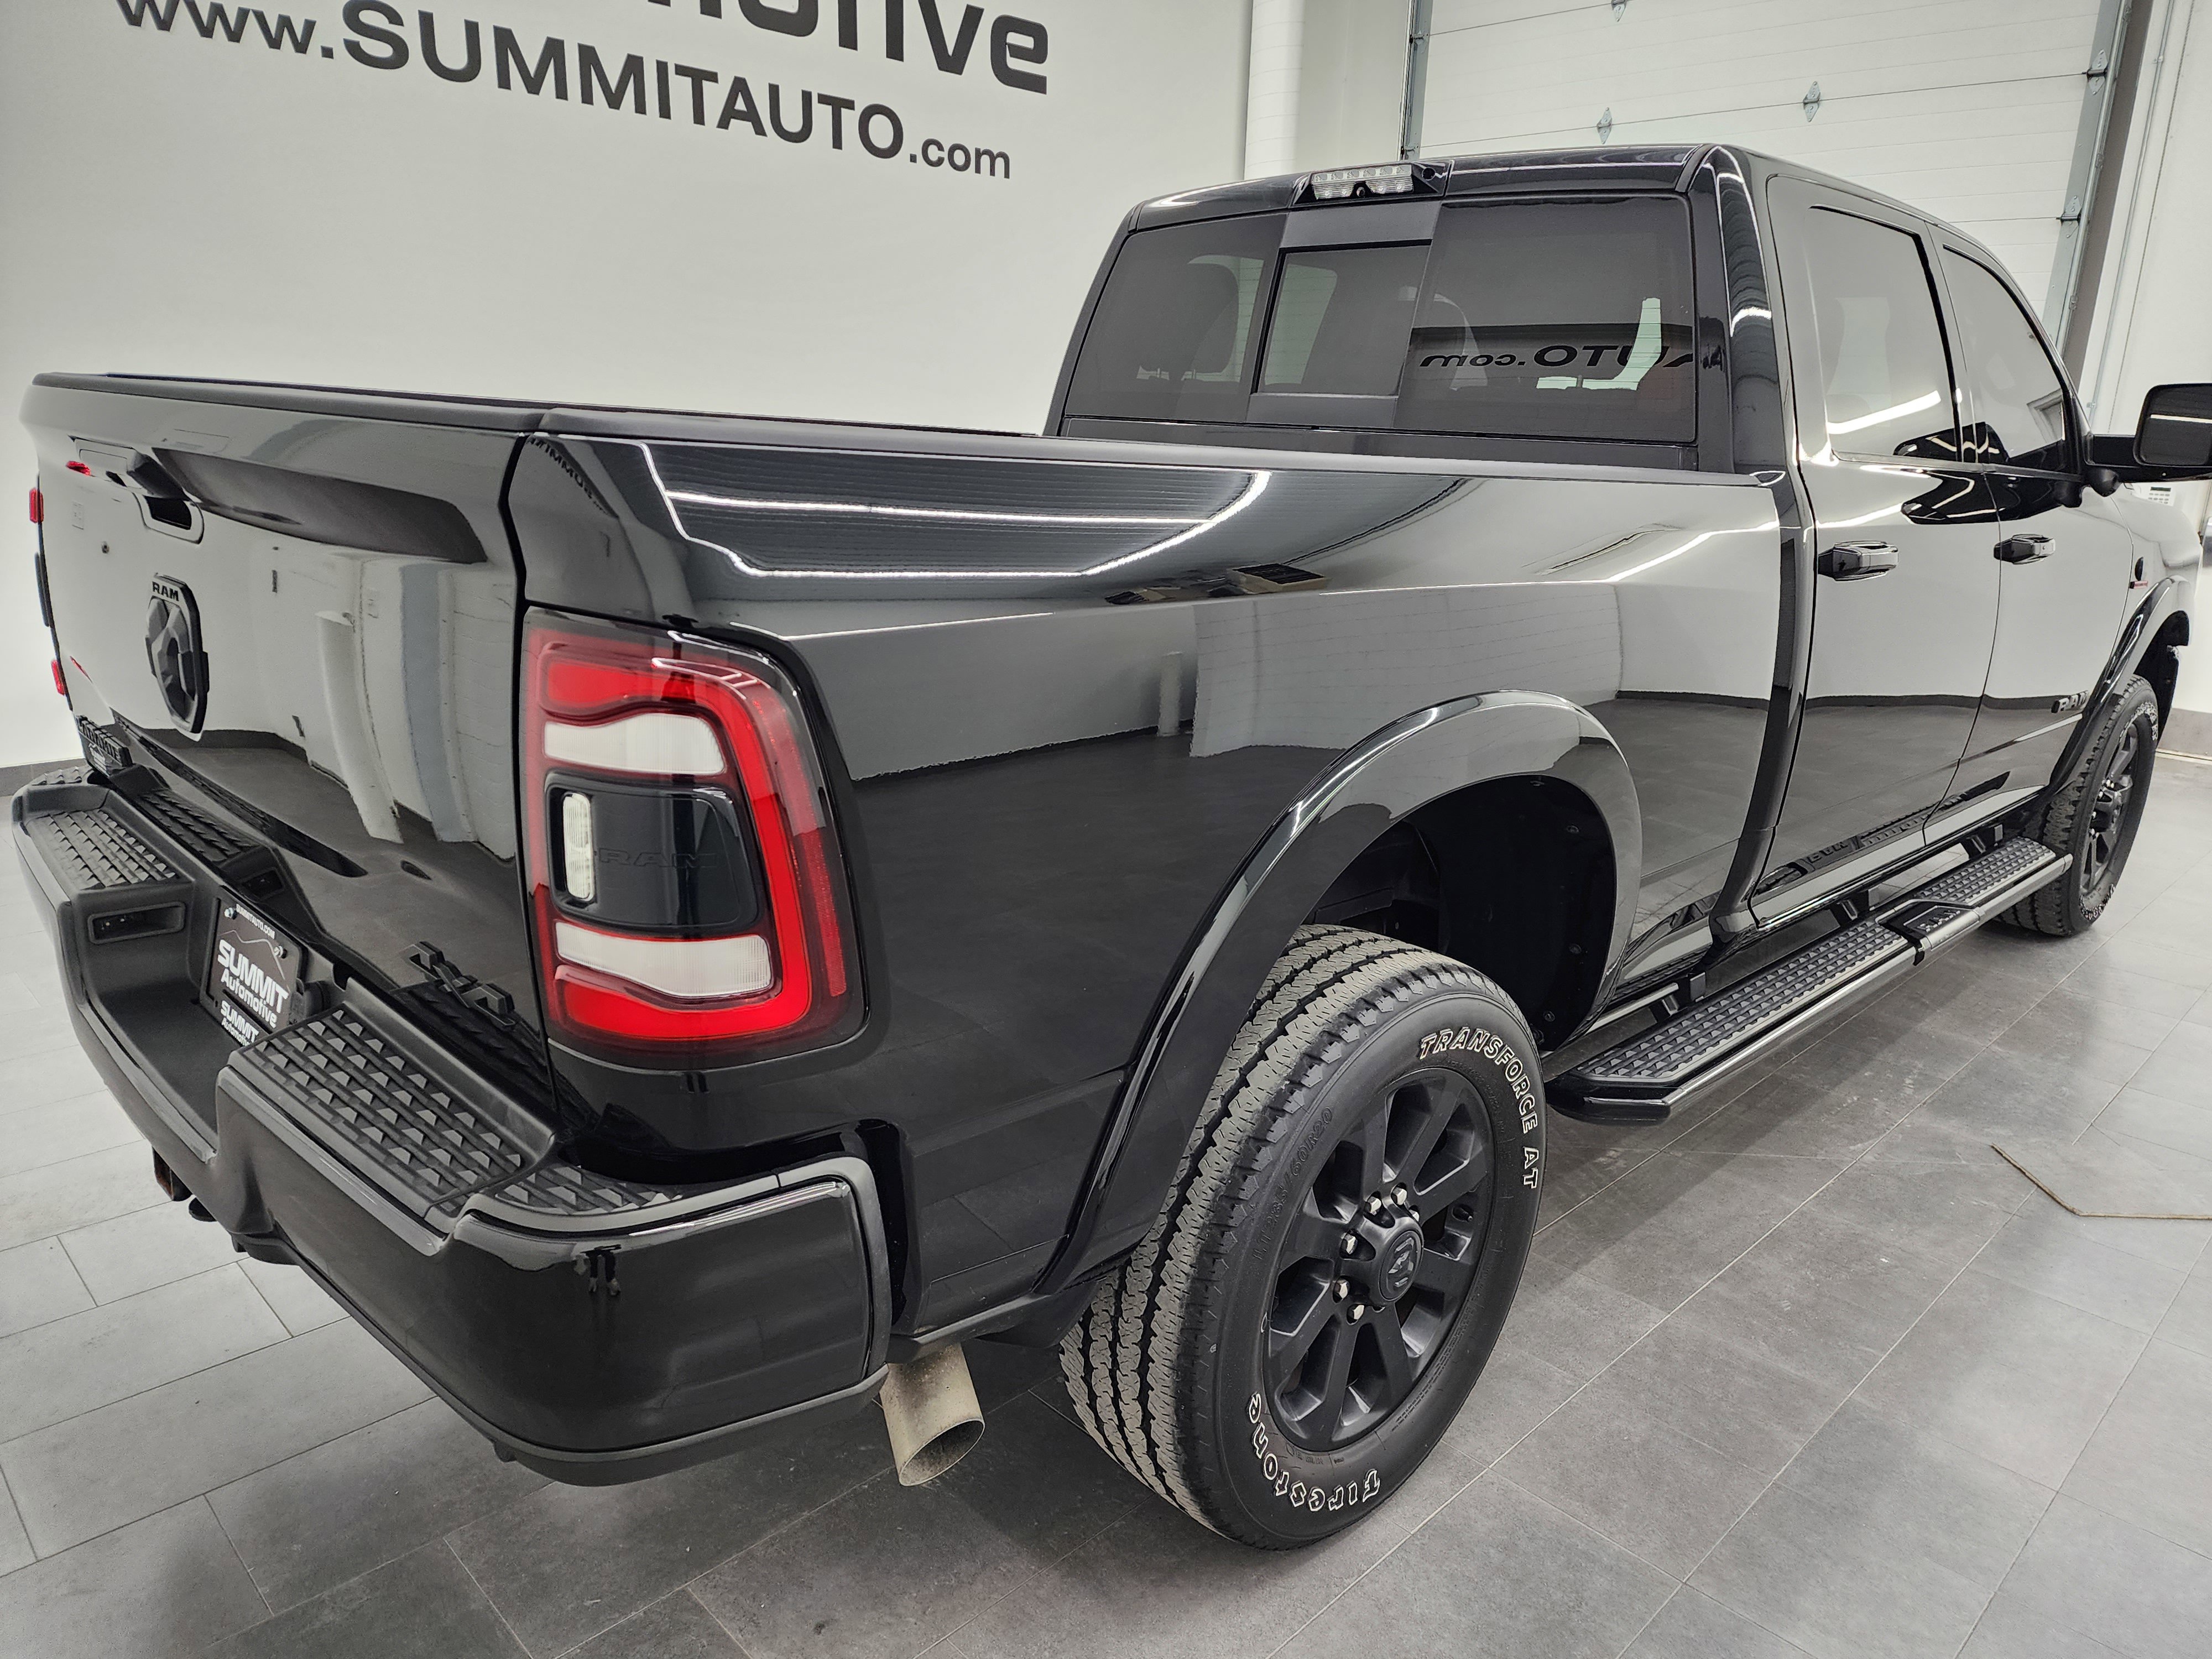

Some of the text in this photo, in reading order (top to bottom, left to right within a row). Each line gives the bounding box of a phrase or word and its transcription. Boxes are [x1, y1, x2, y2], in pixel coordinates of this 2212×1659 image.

[117, 0, 1010, 179] www.SUMMITAUTO.com
[152, 581, 179, 602] RAM
[217, 939, 289, 1014] SUMMIT
[221, 968, 277, 1029] Automotive
[221, 1000, 259, 1044] SUMMIT
[1417, 1026, 1538, 1135] TRANSFORCE
[1522, 1145, 1540, 1190] AT
